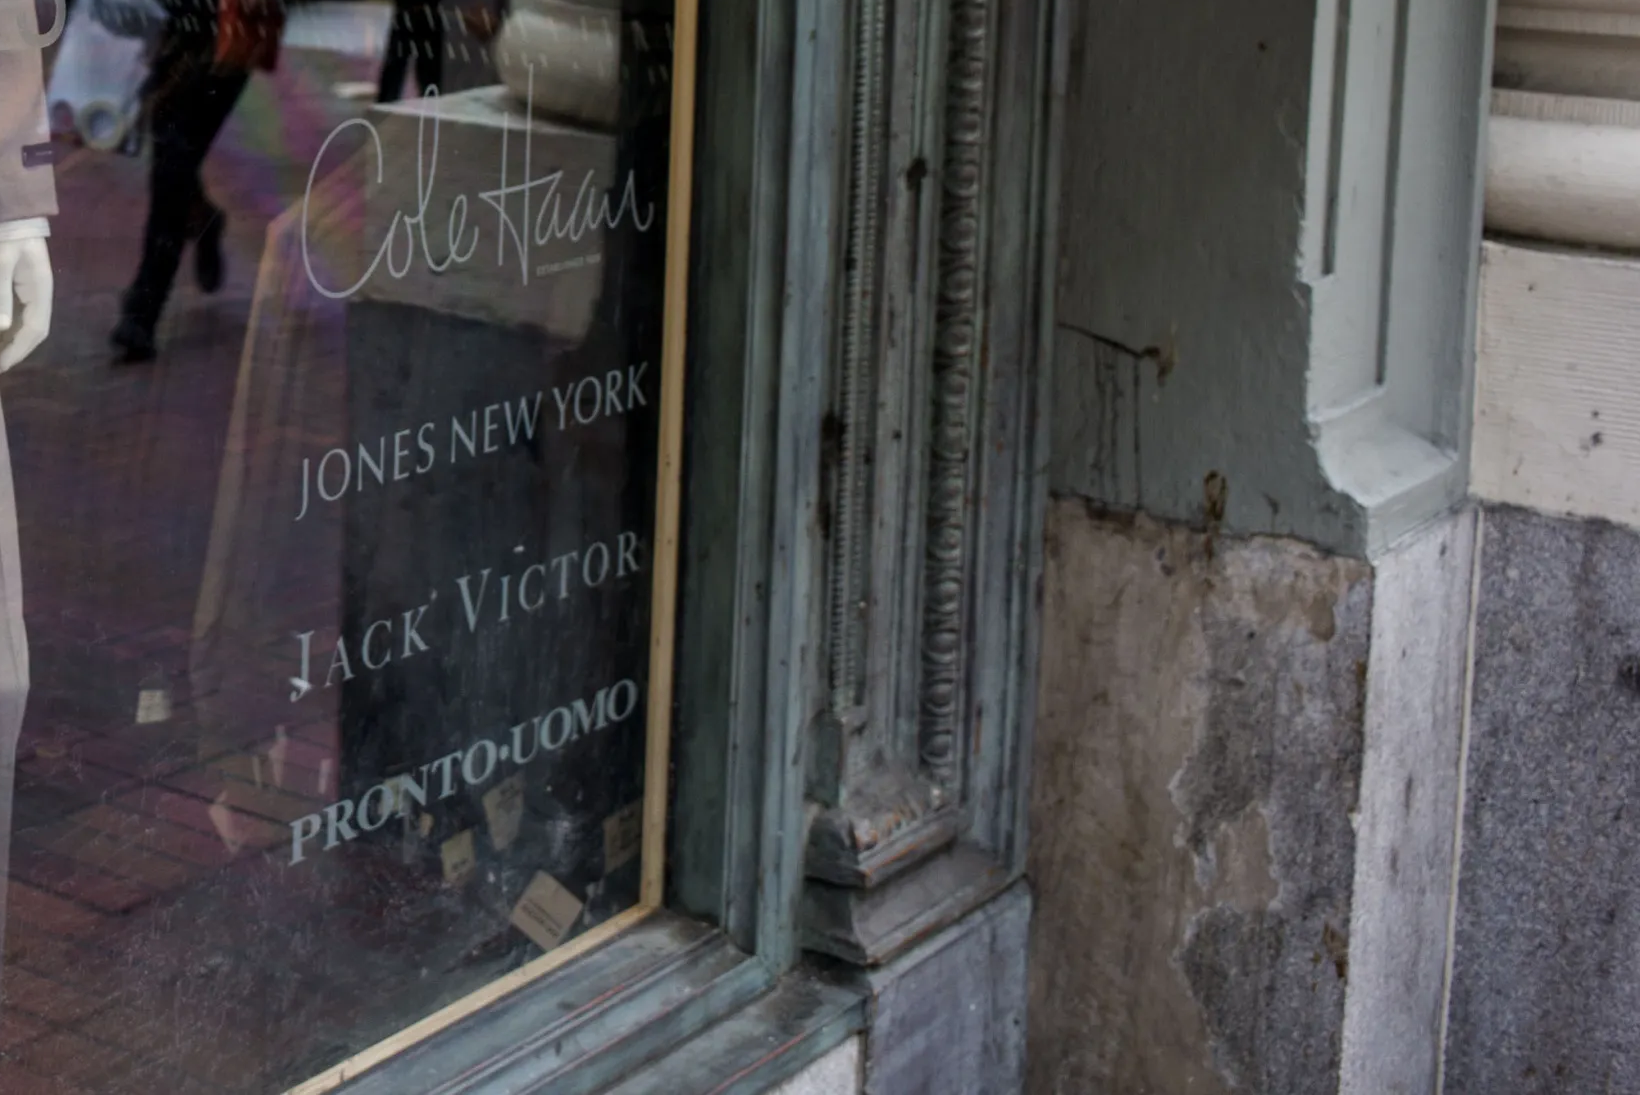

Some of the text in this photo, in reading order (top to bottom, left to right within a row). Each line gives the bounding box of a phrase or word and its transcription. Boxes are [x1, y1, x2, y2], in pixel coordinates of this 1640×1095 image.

[301, 62, 654, 299] Cole Haan
[294, 361, 649, 521] JONES NEW YORK
[289, 603, 432, 703] JACK
